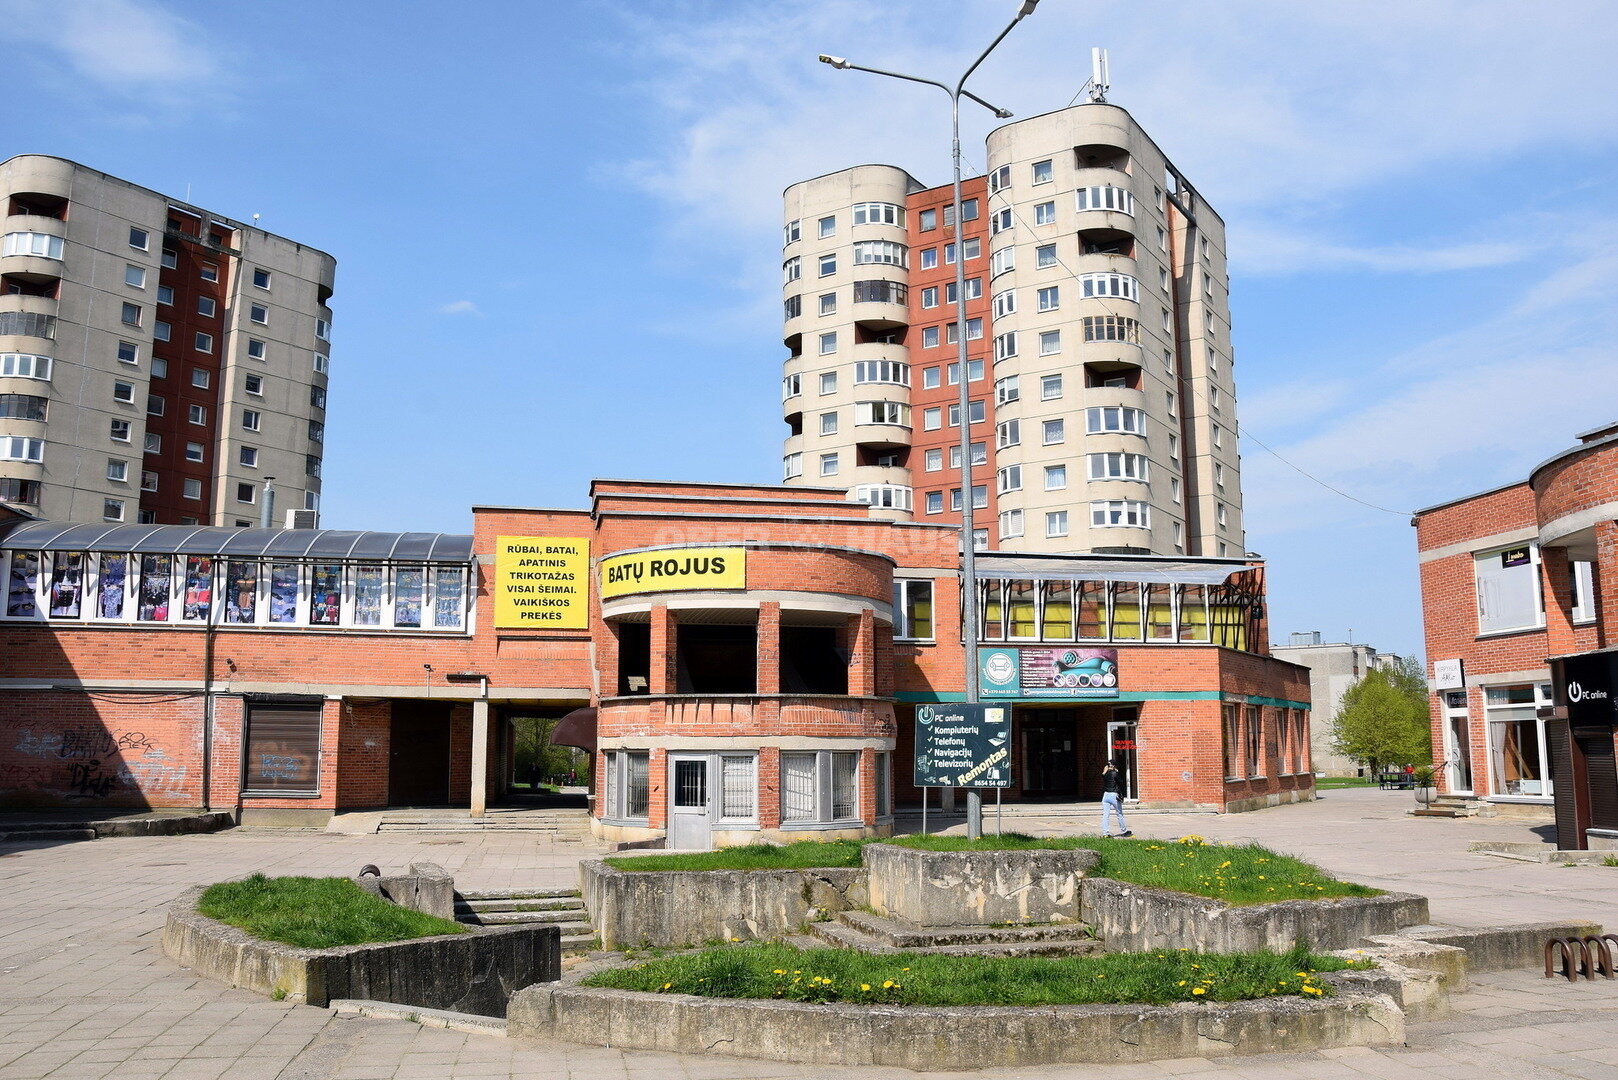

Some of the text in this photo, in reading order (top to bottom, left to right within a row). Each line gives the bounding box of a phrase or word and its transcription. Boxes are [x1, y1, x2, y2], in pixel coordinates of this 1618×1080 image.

[507, 544, 578, 556] RŪBAI, BATAI,
[519, 559, 566, 567] APATINIS
[608, 557, 726, 583] BATŲ ROJUS
[510, 571, 575, 581] TRIKOTAŽAS
[507, 584, 577, 594] VISAI ŠEIMAI.
[513, 597, 570, 607] VAIKIŠKOS
[520, 611, 562, 620] PREKĖS
[1582, 690, 1607, 700] PC online
[934, 714, 964, 722] PC online
[934, 726, 979, 735] Kompiuterių
[934, 737, 966, 746] Telefonų
[934, 748, 972, 758] Navigacijų
[934, 759, 974, 769] Televizorių
[957, 747, 1008, 786] Remontas
